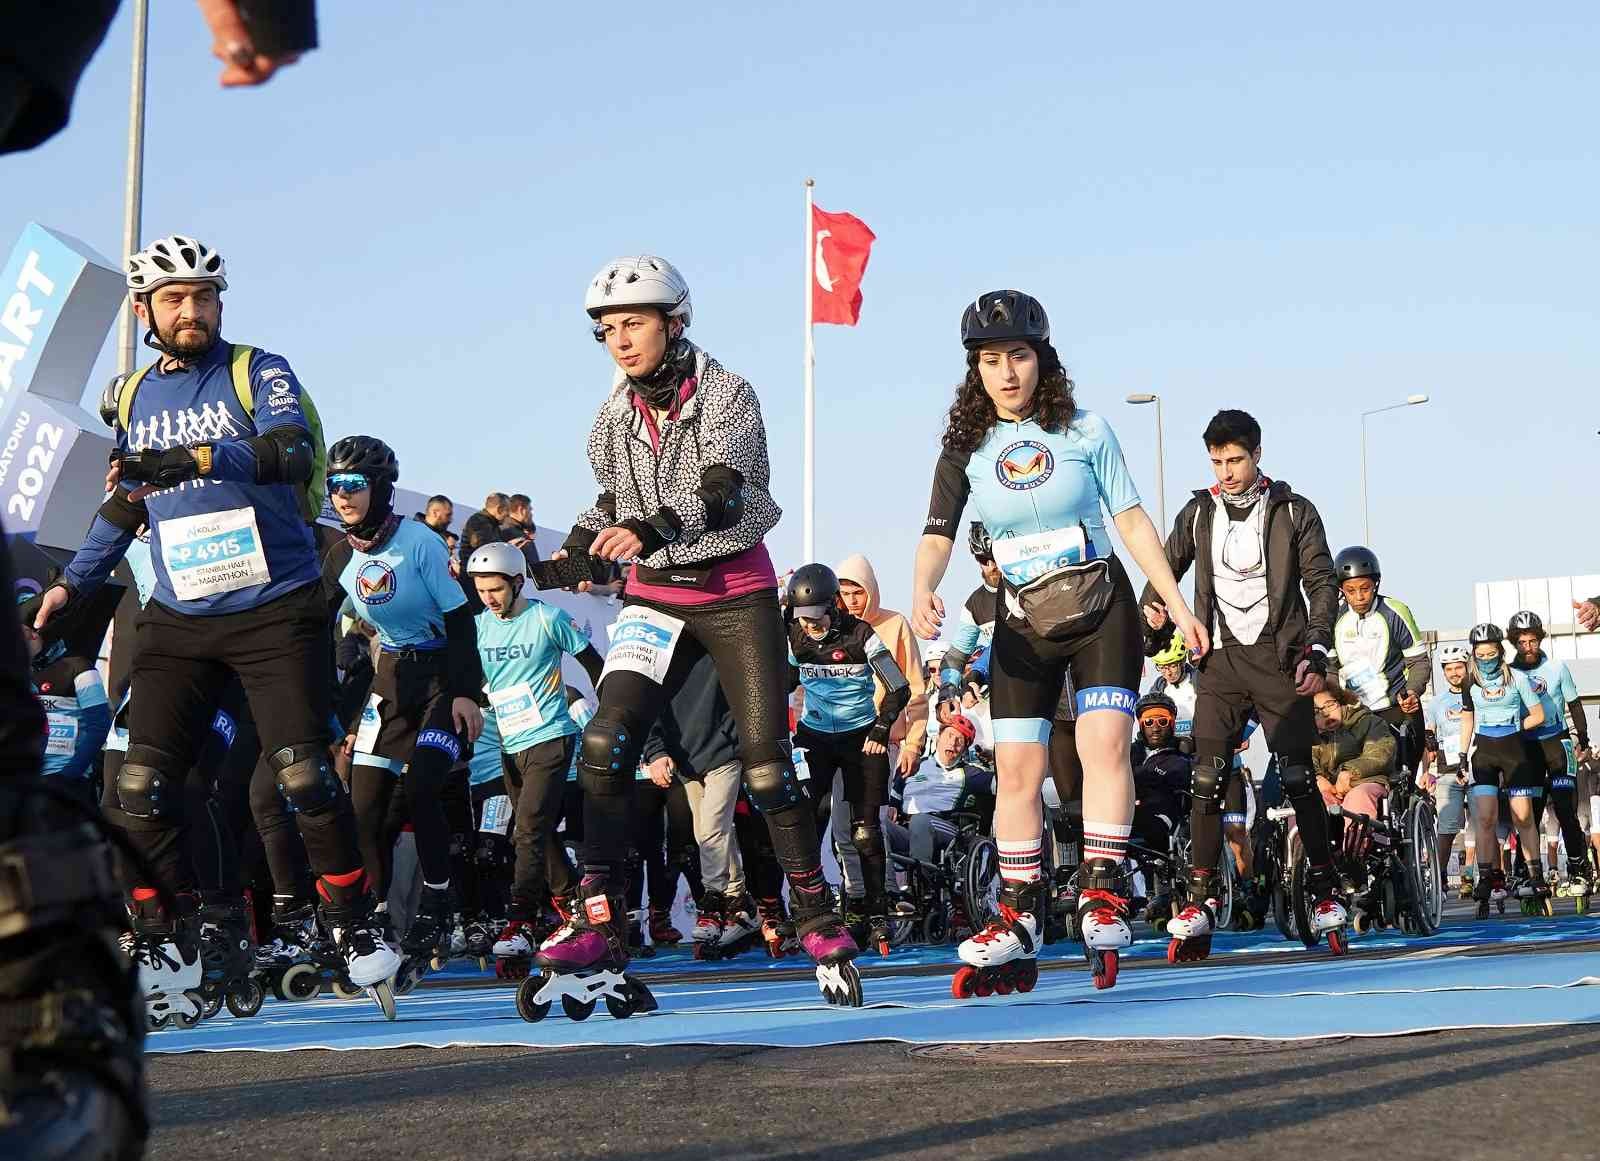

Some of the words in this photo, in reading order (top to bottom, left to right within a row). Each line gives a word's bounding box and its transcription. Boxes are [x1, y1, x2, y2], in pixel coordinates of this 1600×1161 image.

[8, 422, 64, 521] 2022
[196, 537, 241, 560] 4915
[199, 570, 249, 585] MARATHON
[483, 643, 534, 662] TEGV
[822, 665, 853, 678] TÜRK
